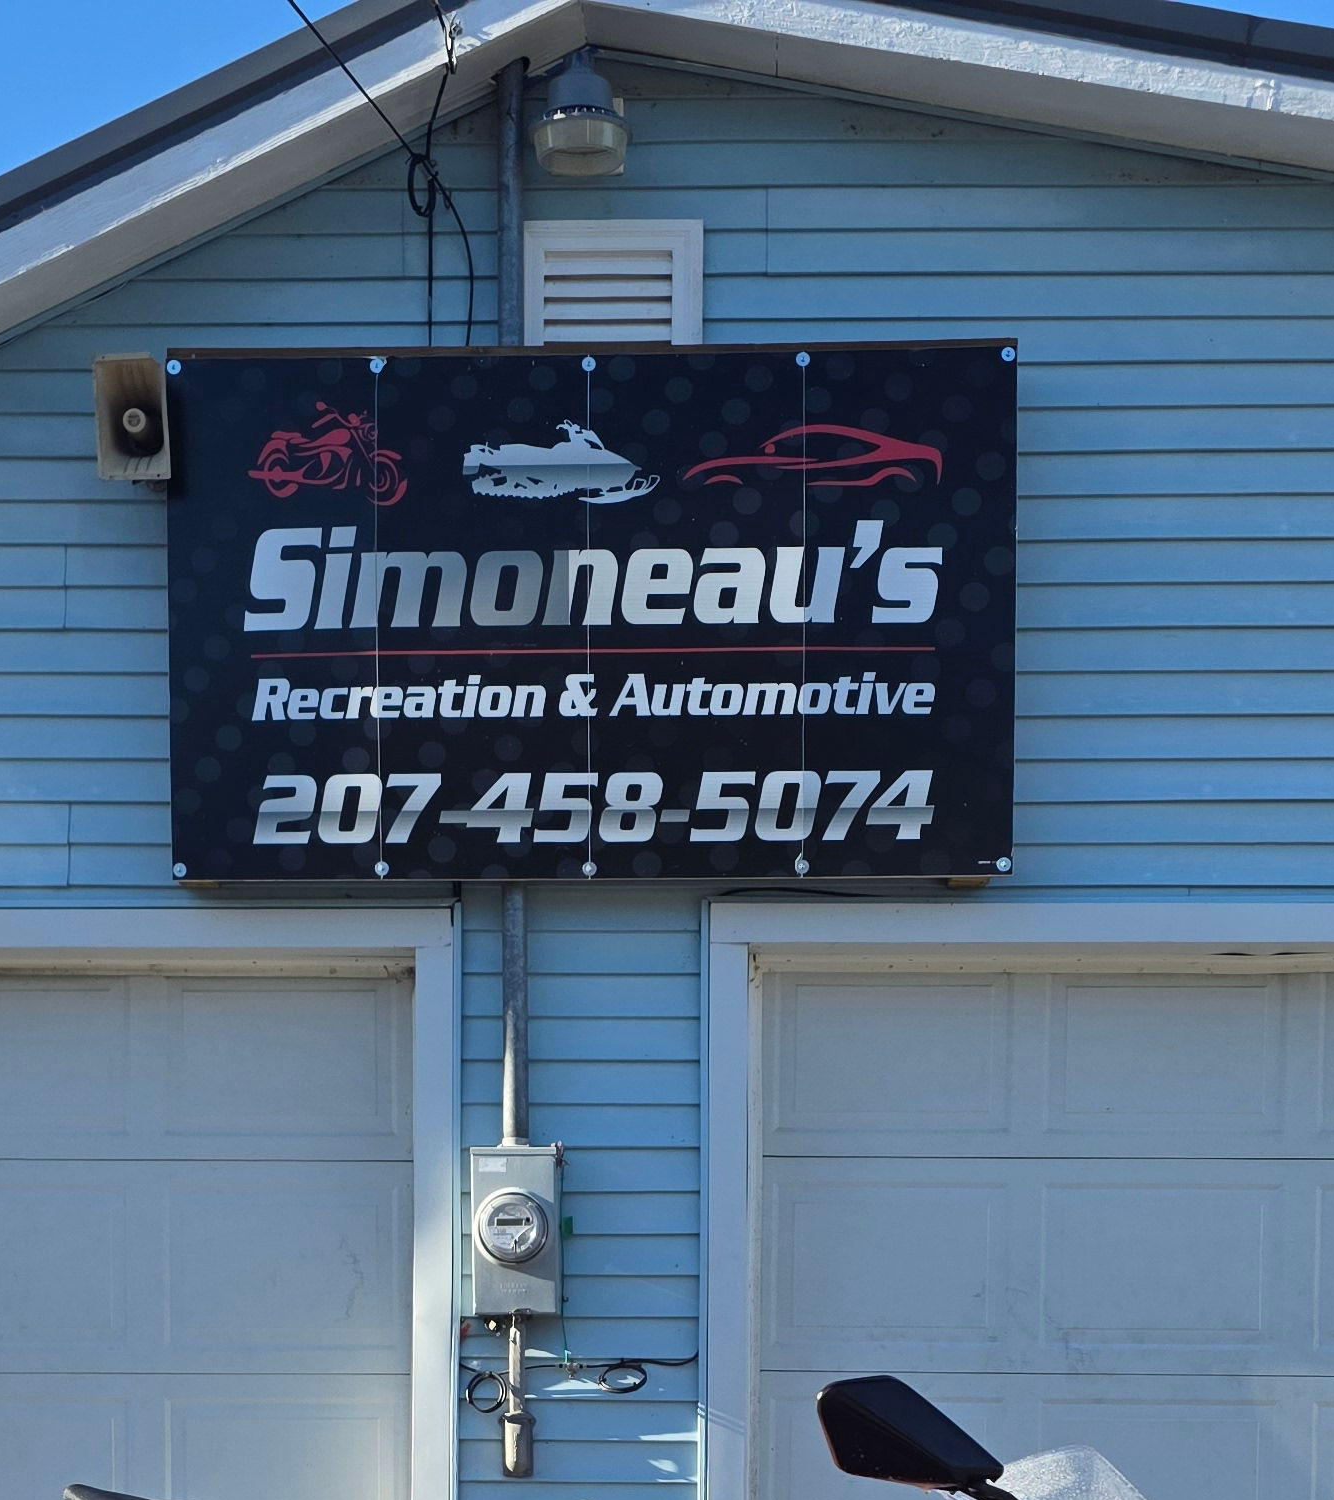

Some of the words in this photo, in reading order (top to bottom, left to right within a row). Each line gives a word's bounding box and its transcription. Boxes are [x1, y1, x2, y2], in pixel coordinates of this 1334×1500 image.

[244, 519, 943, 632] Simoneau's
[251, 674, 547, 721] Recreation
[558, 673, 599, 717] &
[609, 671, 936, 717] Automotive
[252, 769, 935, 845] 207-458-5074
